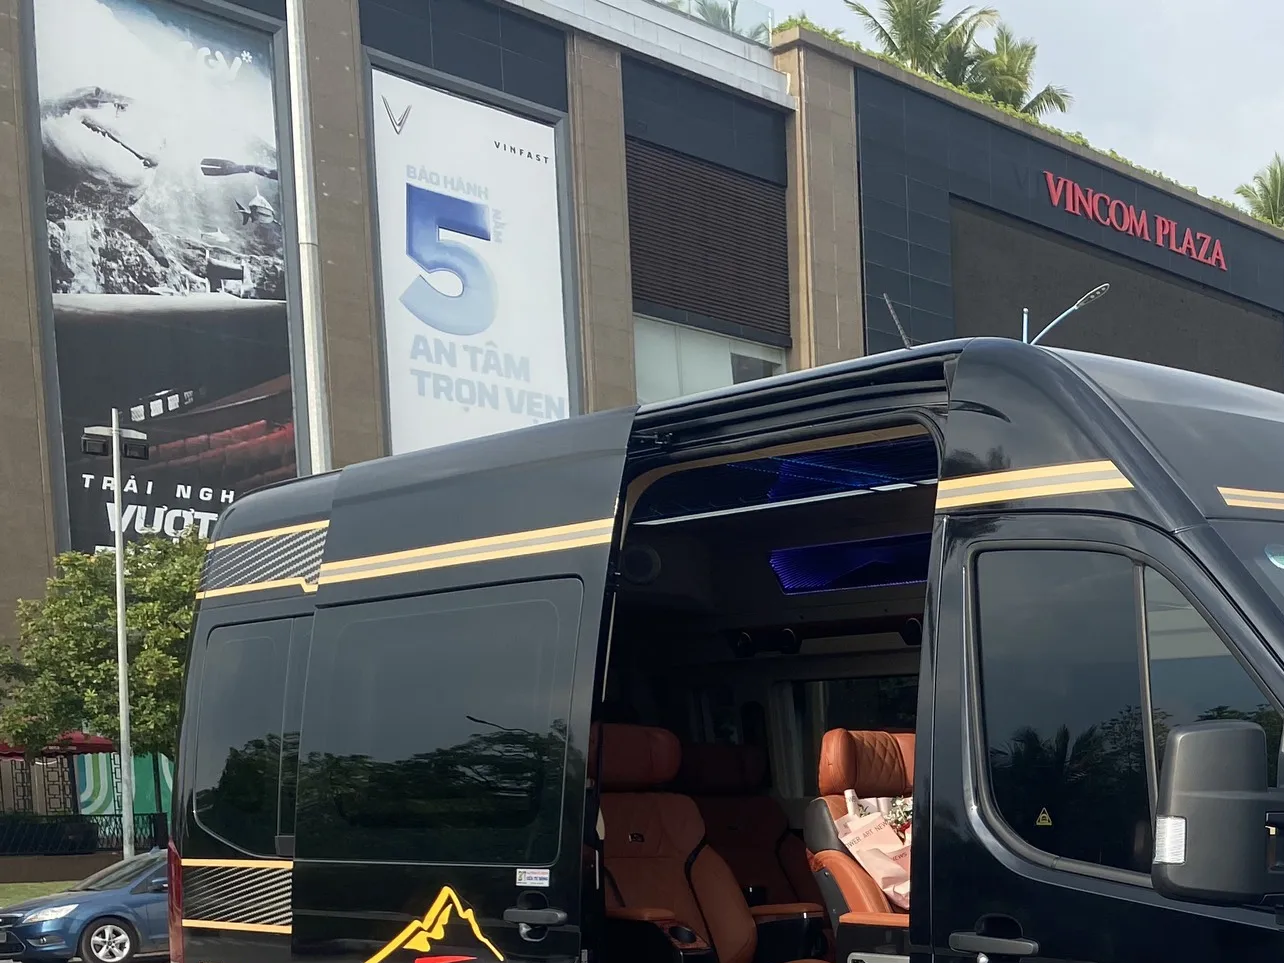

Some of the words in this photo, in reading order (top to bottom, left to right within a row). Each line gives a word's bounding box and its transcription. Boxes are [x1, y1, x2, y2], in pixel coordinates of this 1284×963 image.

[494, 140, 549, 164] VINFAST
[1043, 170, 1151, 242] VINCOM
[1153, 214, 1228, 272] PLAZA
[398, 183, 499, 336] 5
[410, 334, 457, 368] AN
[462, 340, 531, 382] TÂM
[409, 368, 499, 412] TRỌN
[504, 387, 565, 424] VẸN
[106, 502, 218, 544] VƯỢT
